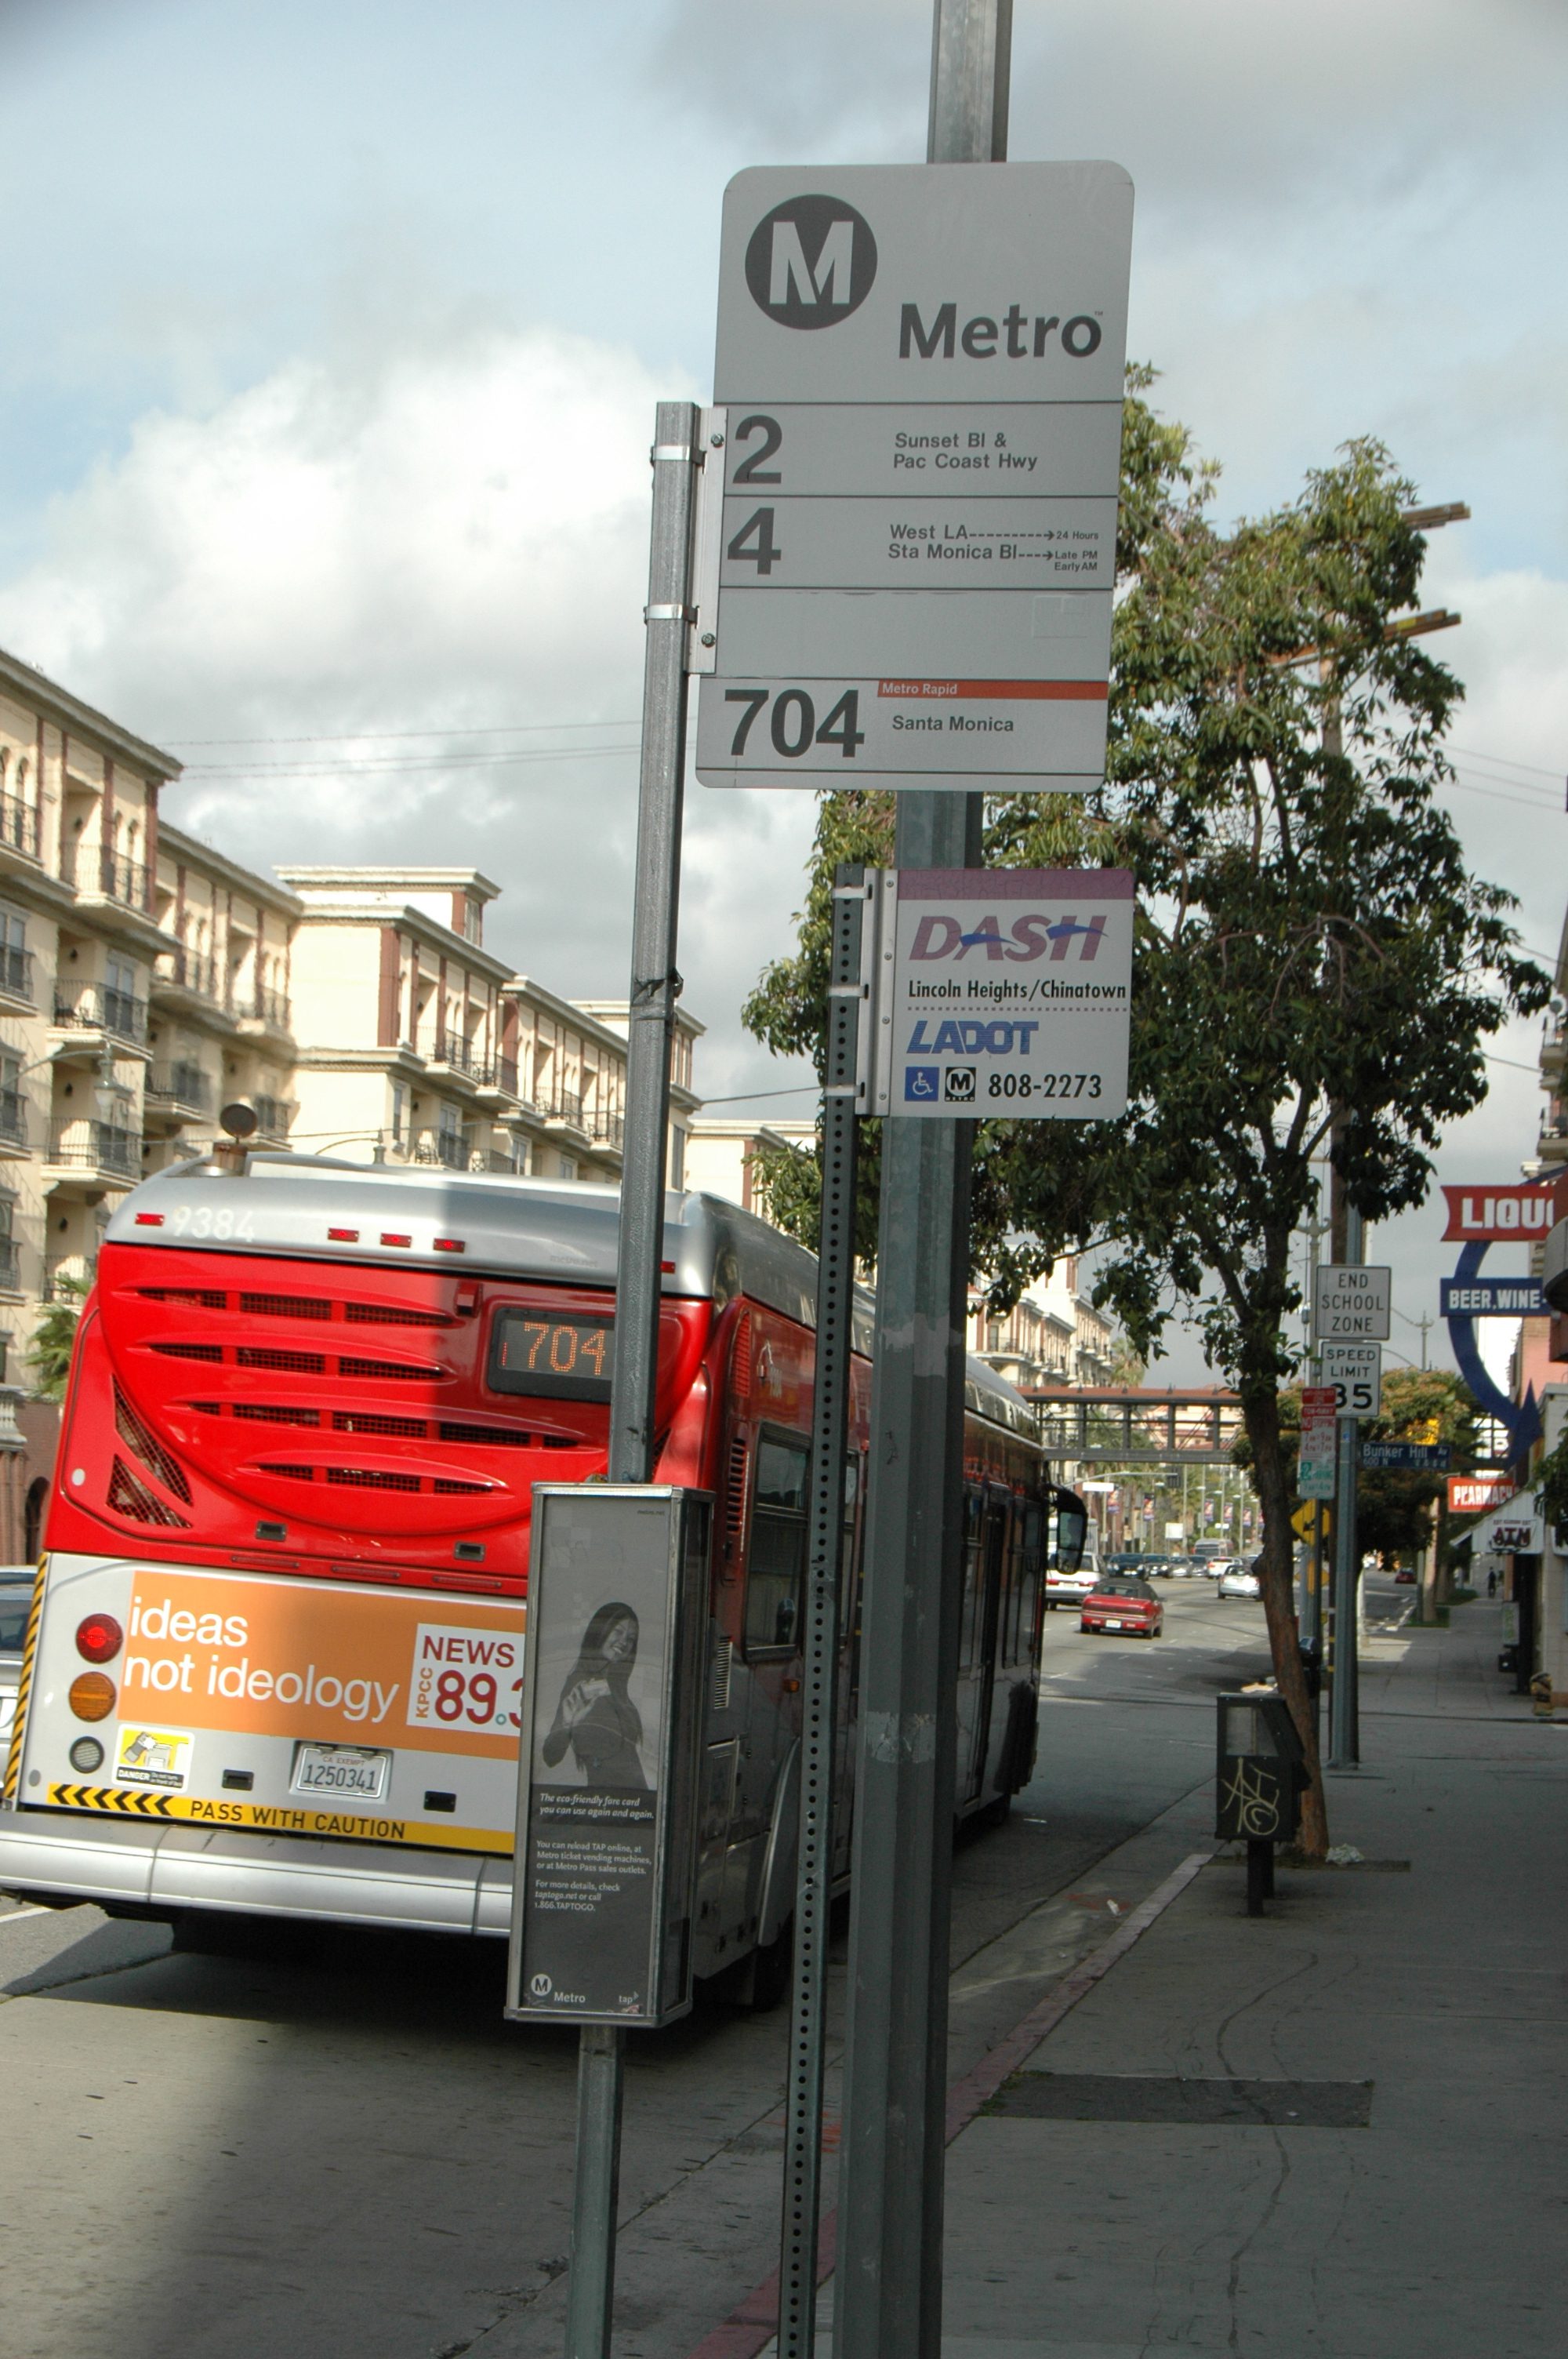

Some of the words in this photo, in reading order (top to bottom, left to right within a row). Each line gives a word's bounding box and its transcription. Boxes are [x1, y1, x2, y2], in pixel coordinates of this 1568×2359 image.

[769, 221, 854, 305] M
[898, 304, 1102, 358] Metro
[895, 433, 959, 448] Sunset
[968, 432, 985, 448] Bl
[994, 433, 1007, 448] &
[732, 414, 782, 484] 2
[894, 454, 926, 469] Pac
[935, 454, 989, 469] Coast
[999, 453, 1037, 471] Hwy
[890, 524, 935, 540] West
[944, 525, 968, 540] LA
[1056, 531, 1069, 540] 24
[1073, 531, 1098, 540] Hours
[728, 507, 782, 575] 4
[887, 543, 920, 559] Sta
[927, 543, 993, 559] Monica
[1000, 543, 1018, 559] Bl
[1054, 551, 1078, 559] Late
[1082, 551, 1098, 559] PM
[1054, 562, 1080, 572] Early
[1081, 562, 1098, 571] AM
[883, 683, 919, 695] Metro
[923, 683, 957, 696] Rapid
[724, 689, 865, 758] 704
[892, 715, 943, 732] Santa
[949, 716, 1014, 732] Monica
[909, 914, 1109, 962] DASH
[909, 980, 961, 998] Lincoln
[906, 1020, 1040, 1055] LADOT
[950, 1073, 971, 1090] M
[989, 1074, 1102, 1098] 808-2273
[173, 1205, 255, 1242] 9384
[1338, 1273, 1369, 1289] END
[1322, 1294, 1384, 1310] SCHOOL
[1332, 1317, 1373, 1332] ZONE
[524, 1321, 606, 1376] 704
[1327, 1349, 1376, 1361] SPEED
[1330, 1366, 1370, 1378] LIMIT
[1363, 1444, 1403, 1458] Bunker
[1409, 1445, 1428, 1458] Hill
[1363, 1457, 1380, 1466] 600
[130, 1596, 249, 1648] ideas
[422, 1635, 515, 1668] NEWS
[124, 1653, 195, 1693] not
[208, 1654, 400, 1723] ideology
[416, 1667, 433, 1718] KPCC
[303, 1764, 376, 1790] 1250341
[539, 1793, 554, 1802] The
[556, 1793, 603, 1806] eco-friendly
[604, 1797, 620, 1807] fare
[622, 1797, 640, 1806] card
[539, 1806, 554, 1815] you
[588, 1809, 611, 1818] again
[612, 1808, 628, 1817] and
[191, 1801, 242, 1822] PASS
[252, 1807, 306, 1829] WITH
[315, 1814, 405, 1840] CAUTION
[567, 1841, 590, 1850] reload
[537, 1851, 559, 1859] Metro
[561, 1852, 581, 1860] ticket
[583, 1852, 612, 1864] vending
[555, 1862, 578, 1870] Metro
[535, 1978, 548, 1991] M
[554, 1991, 586, 2003] Metro
[619, 1994, 633, 2004] tap
